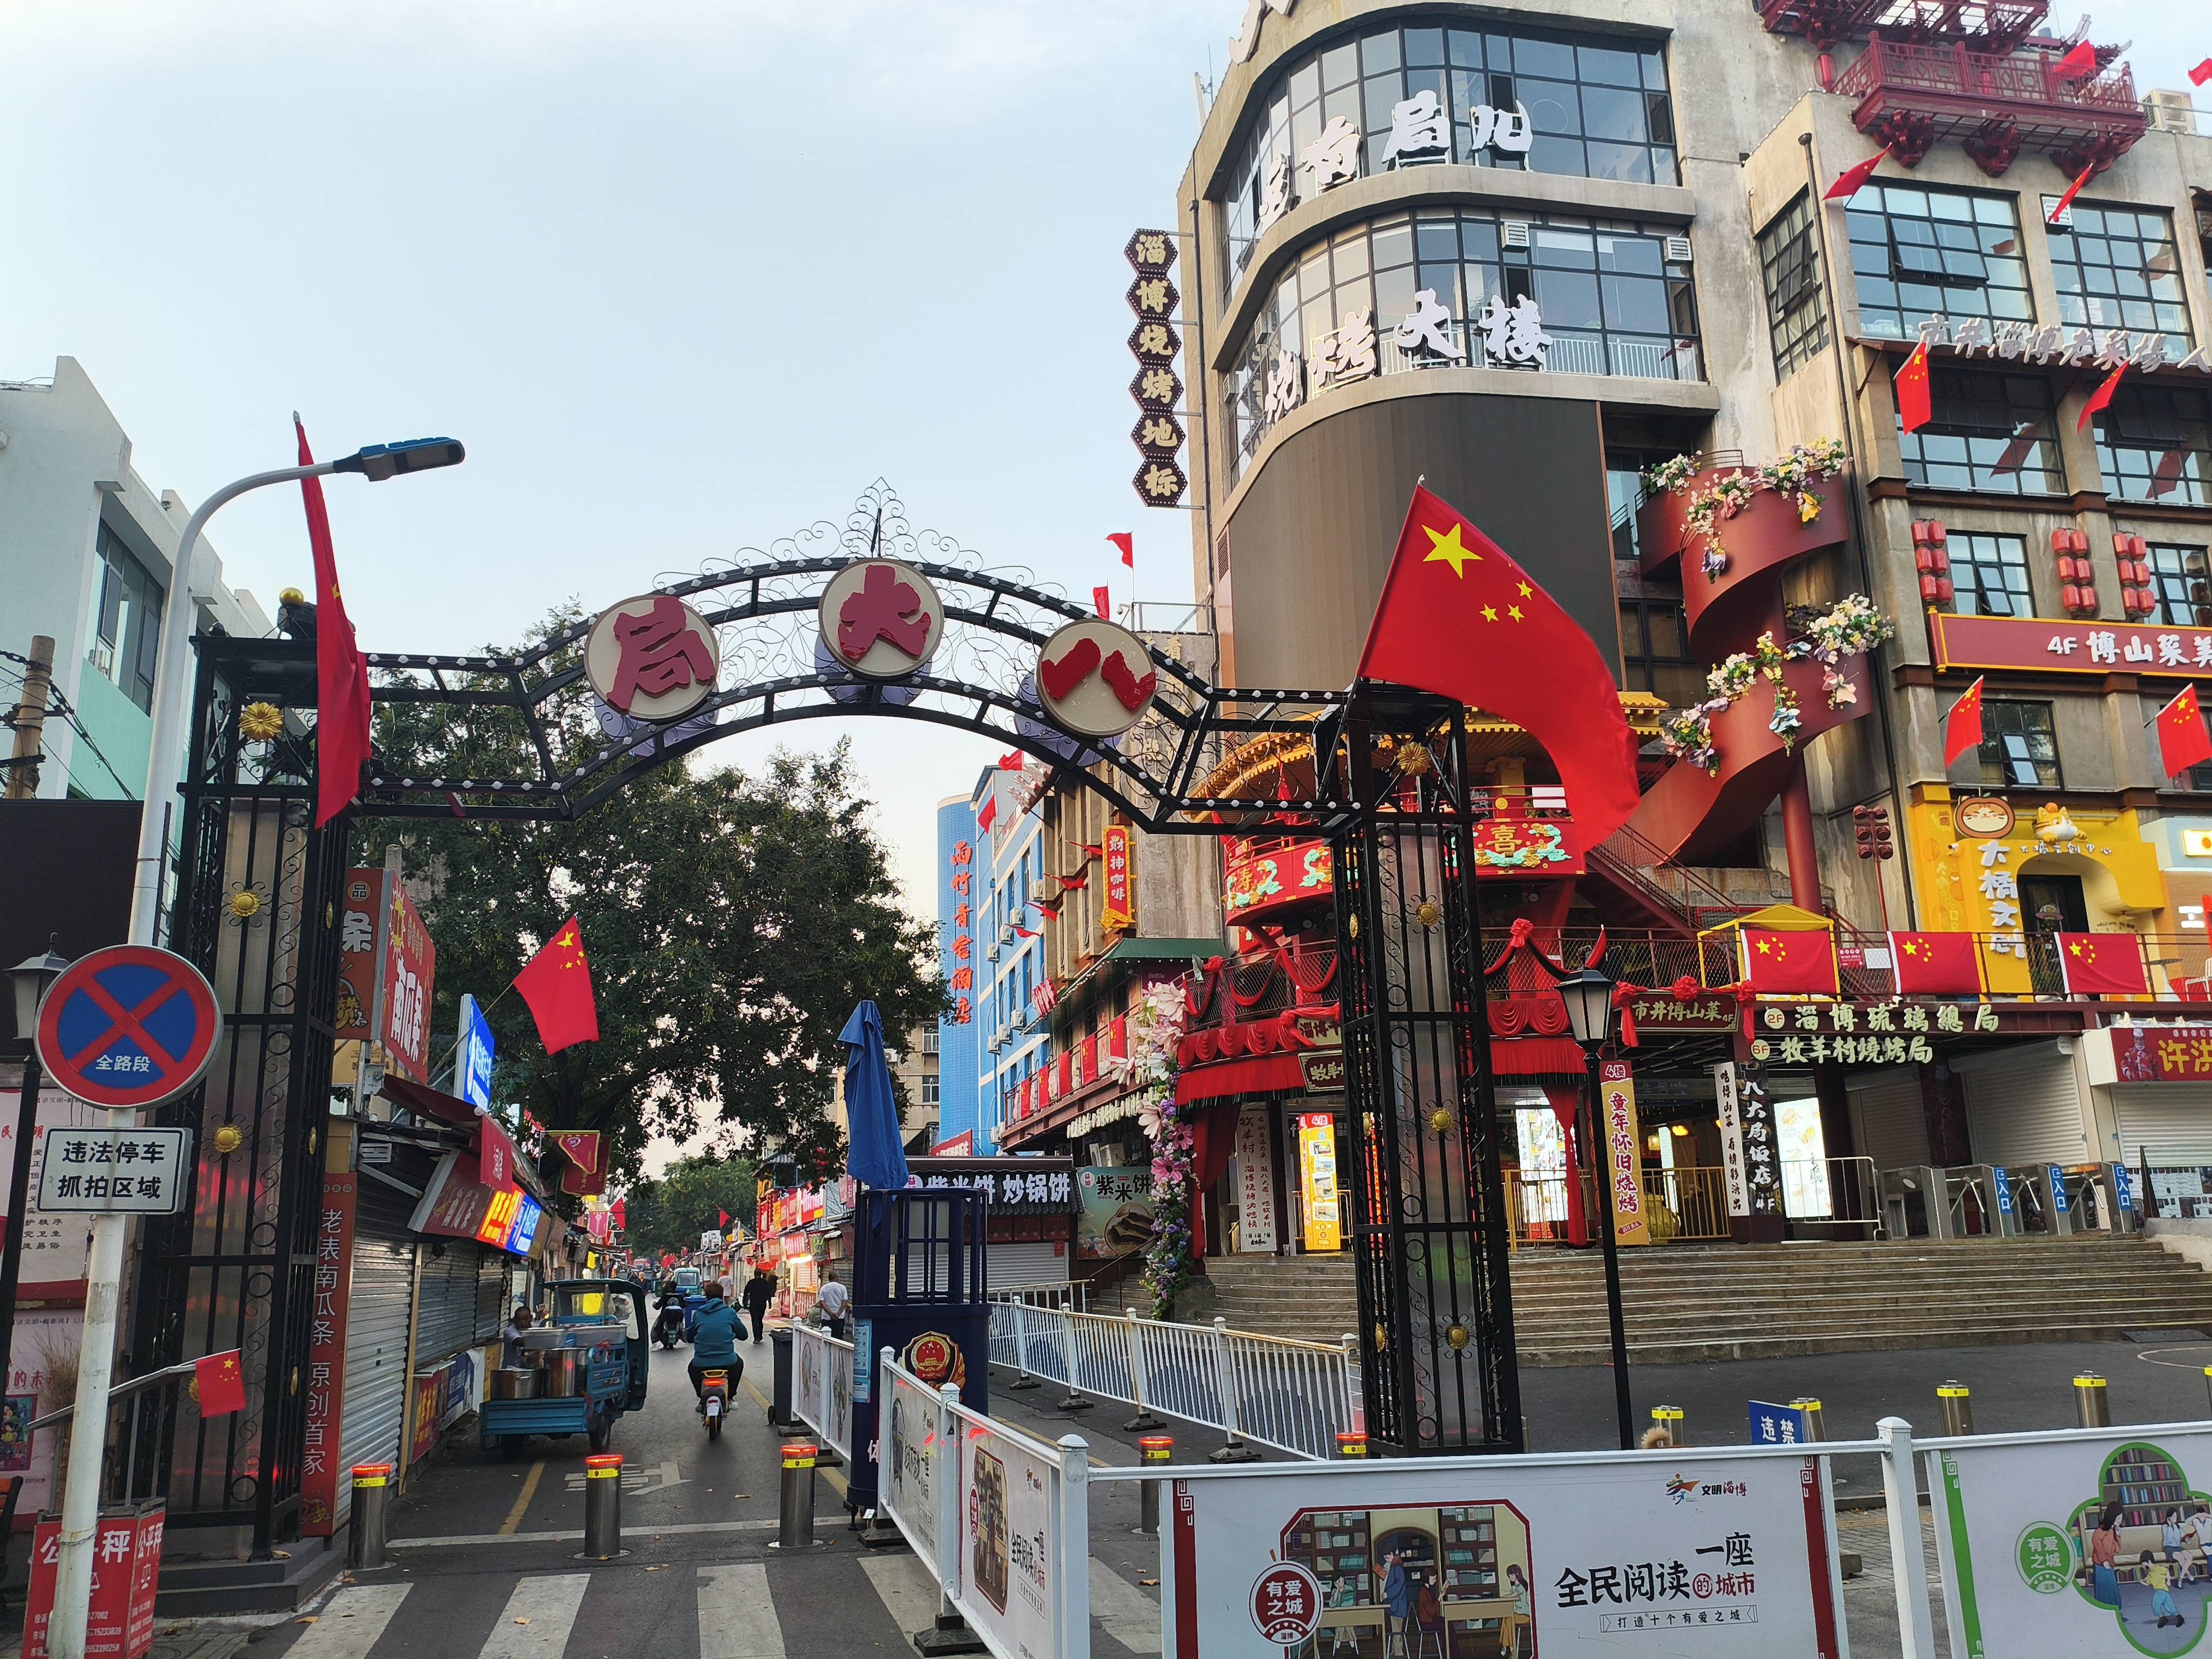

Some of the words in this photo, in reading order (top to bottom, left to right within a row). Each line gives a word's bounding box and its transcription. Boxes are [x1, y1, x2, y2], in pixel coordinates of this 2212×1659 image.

[1135, 234, 1178, 496] 淄博烧烤地标
[1265, 288, 1553, 423] 烧烤大楼
[2047, 636, 2078, 655] 4F
[1486, 825, 1523, 853] 喜
[342, 910, 373, 953] 条
[1631, 1000, 1722, 1021] 市井博山菜
[1768, 1014, 1783, 1023] 2F
[1795, 1003, 1998, 1033] 淄博琉璃總局
[1752, 1045, 1768, 1054] 6F
[96, 1054, 151, 1073] 全路段
[1742, 1081, 1771, 1185] 八大局饭店
[62, 1141, 165, 1164] 违法停车
[1609, 1092, 1638, 1213] 童年怀旧烧烤
[57, 1175, 161, 1199] 抓拍区域
[1002, 1173, 1070, 1204] 炒锅饼
[1096, 1174, 1152, 1203] 紫米饼
[1998, 1184, 2011, 1210] 入口
[2052, 1183, 2066, 1208] 入口
[2118, 1180, 2130, 1206] 入口
[1756, 1198, 1775, 1211] 4F
[312, 1208, 343, 1346] 老表南瓜条
[304, 1362, 331, 1475] 原创首家
[1701, 1481, 1748, 1497] 文明淄博
[40, 1530, 131, 1564] 公秤
[1695, 1532, 1755, 1567] 一座
[2028, 1536, 2059, 1552] 有爱
[2030, 1554, 2061, 1569] 之城
[1265, 1580, 1302, 1597] 有爱
[1267, 1598, 1304, 1616] 之城
[1617, 1608, 1741, 1628] 打造十个有爱之城
